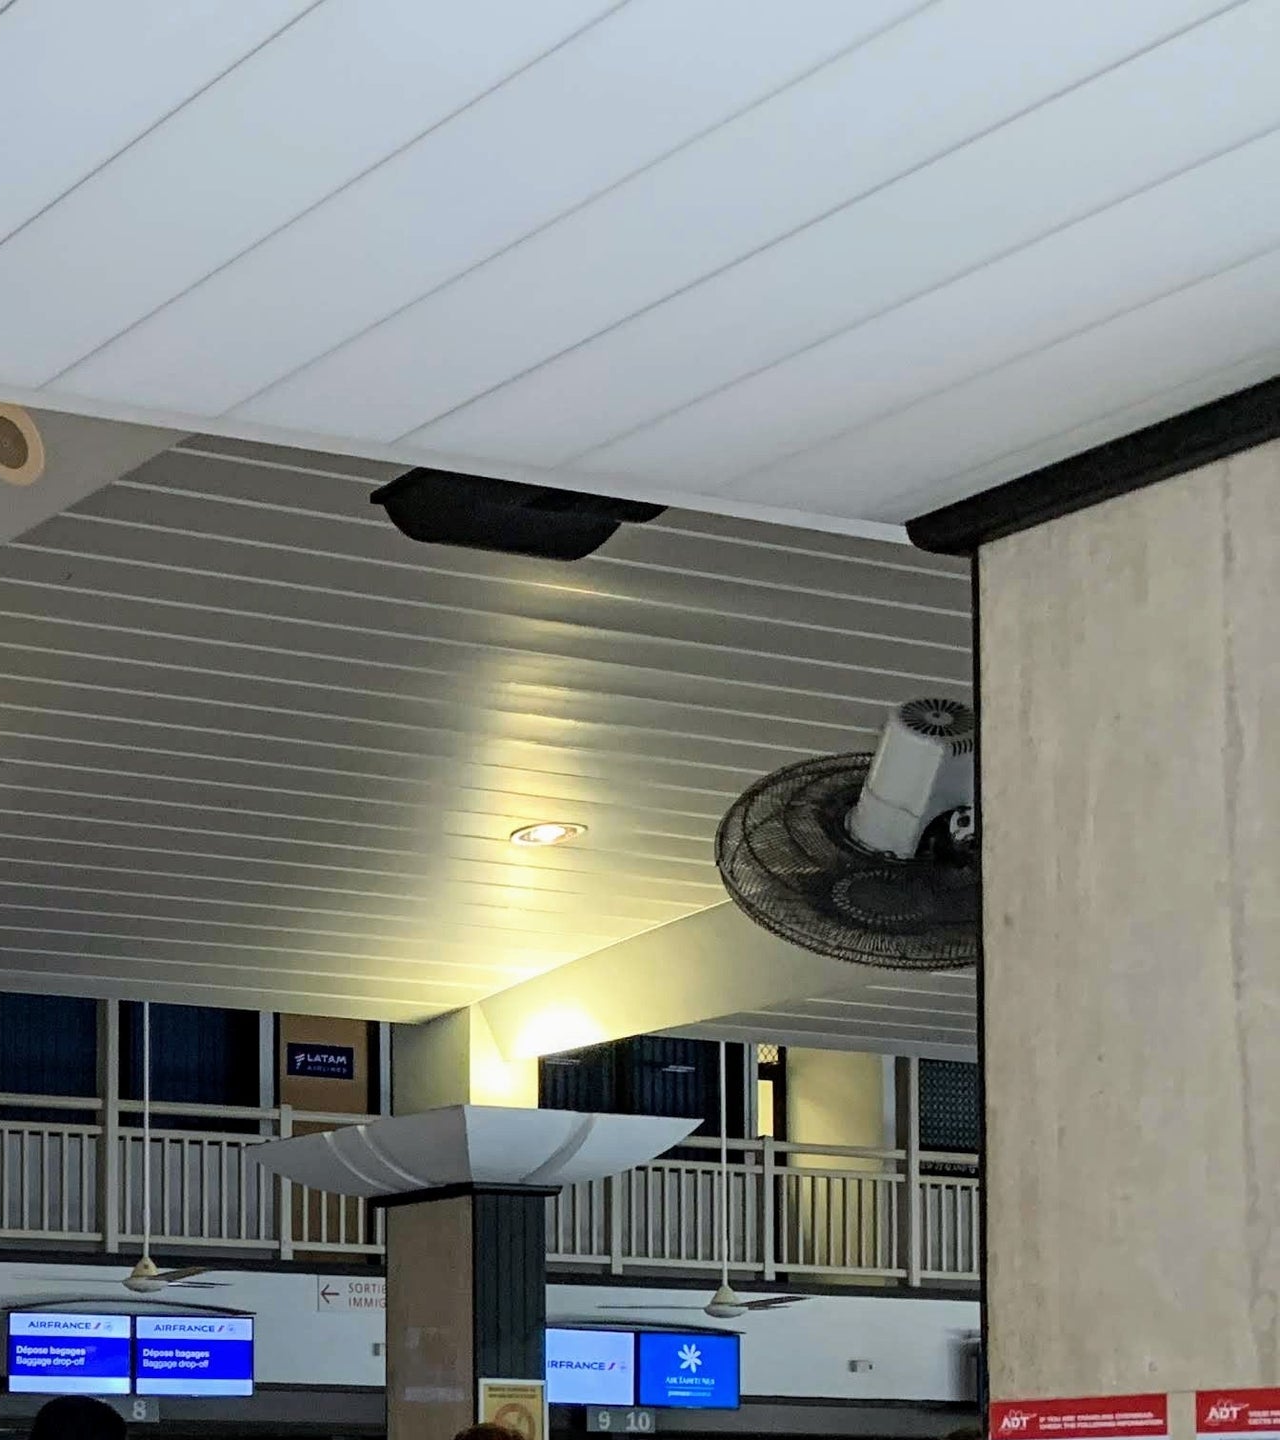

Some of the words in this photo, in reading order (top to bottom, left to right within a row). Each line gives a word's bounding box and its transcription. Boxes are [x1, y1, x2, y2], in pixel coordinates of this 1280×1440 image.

[307, 1053, 347, 1065] LATAM
[28, 1321, 92, 1330] AIRFRANCE
[154, 1324, 215, 1332] AIRFRANCE
[53, 1357, 85, 1367] drop-off
[178, 1360, 209, 1369] drop-off
[547, 1360, 605, 1371] IRFRANCE
[133, 1400, 146, 1420] 8
[1208, 1406, 1242, 1420] ADT
[598, 1411, 610, 1430] 9
[626, 1411, 651, 1431] 10
[1000, 1416, 1031, 1430] ADT
